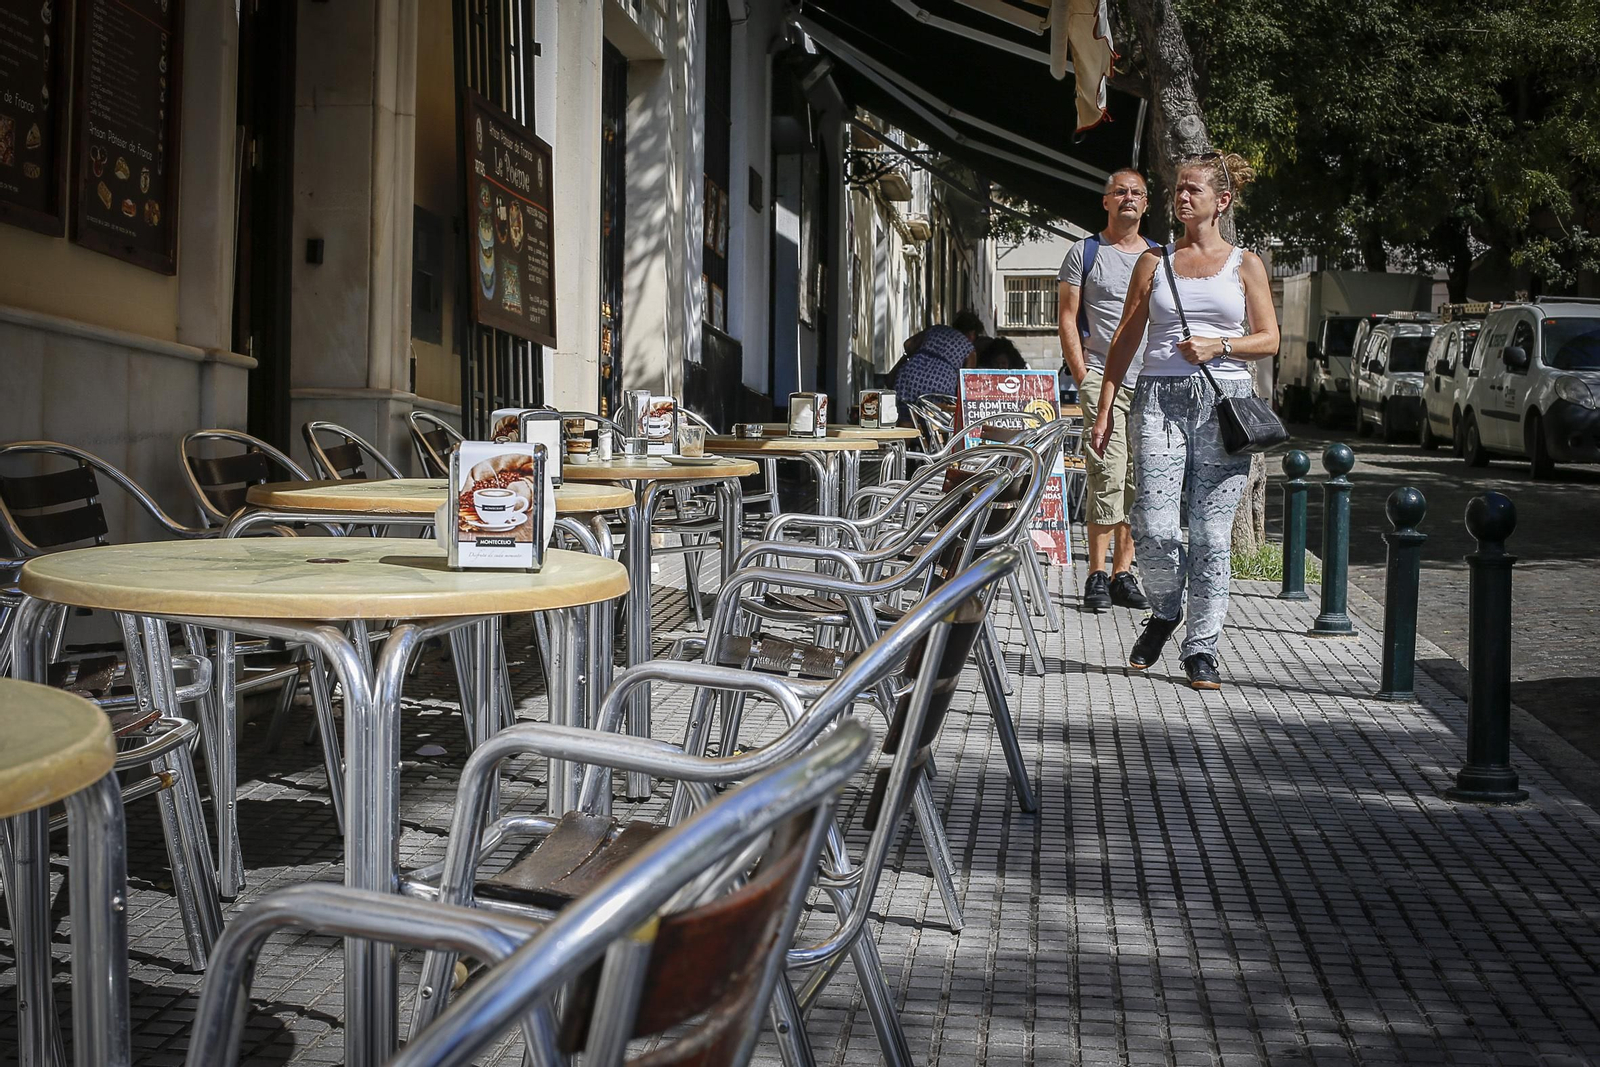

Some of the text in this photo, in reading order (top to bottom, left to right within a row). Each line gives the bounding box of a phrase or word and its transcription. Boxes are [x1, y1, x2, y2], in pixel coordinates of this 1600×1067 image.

[4, 89, 13, 104] de
[494, 146, 503, 177] Le
[967, 401, 1019, 410] SE ADMITEN
[995, 420, 1023, 428] CALLE
